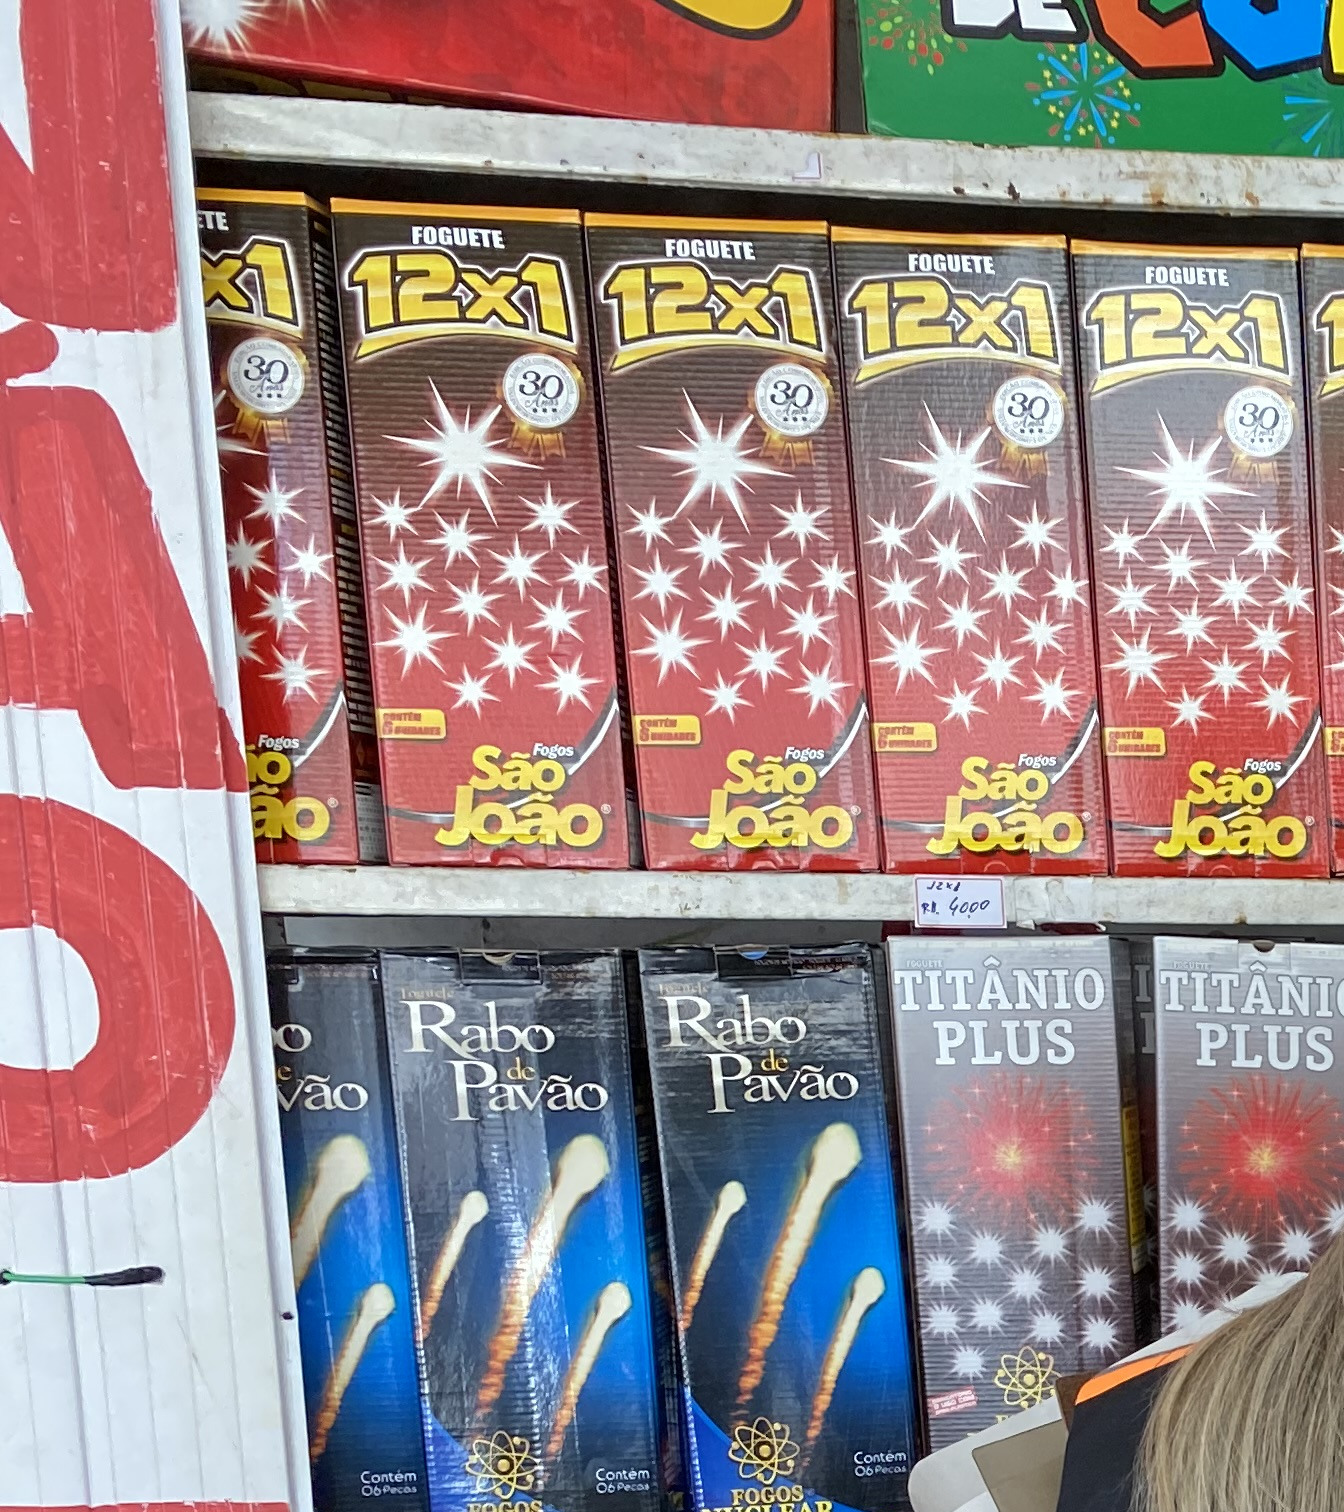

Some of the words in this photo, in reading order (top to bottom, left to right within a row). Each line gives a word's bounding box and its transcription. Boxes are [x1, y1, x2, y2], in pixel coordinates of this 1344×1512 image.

[411, 225, 506, 250] FOGUETE
[664, 238, 756, 261] FOGUETE
[908, 253, 995, 275] FOGUETE
[1145, 266, 1229, 287] FOGUETE
[347, 248, 575, 342] 12x1
[602, 260, 827, 357] 12x1
[847, 276, 1061, 364] 12x1
[1084, 286, 1293, 373] 12x1
[243, 350, 289, 385] 30
[518, 371, 564, 403] 30
[1006, 392, 1049, 420] 30
[469, 744, 566, 795] São
[532, 742, 575, 761] Fogos
[724, 749, 818, 797] São
[434, 793, 605, 850] João
[690, 788, 853, 851] João
[948, 898, 990, 919] 40,00
[894, 956, 1107, 1012] TITÂNIO
[403, 999, 556, 1061] Rabo
[661, 993, 808, 1051] Rabo
[933, 1019, 1077, 1066] PLUS
[505, 1058, 537, 1081] de
[761, 1049, 790, 1073] de
[1196, 1023, 1335, 1071] PLUS
[449, 1061, 609, 1122] Pavão
[707, 1052, 860, 1115] Pavão
[853, 1450, 907, 1465] Contém
[731, 1486, 805, 1506] FOGOS
